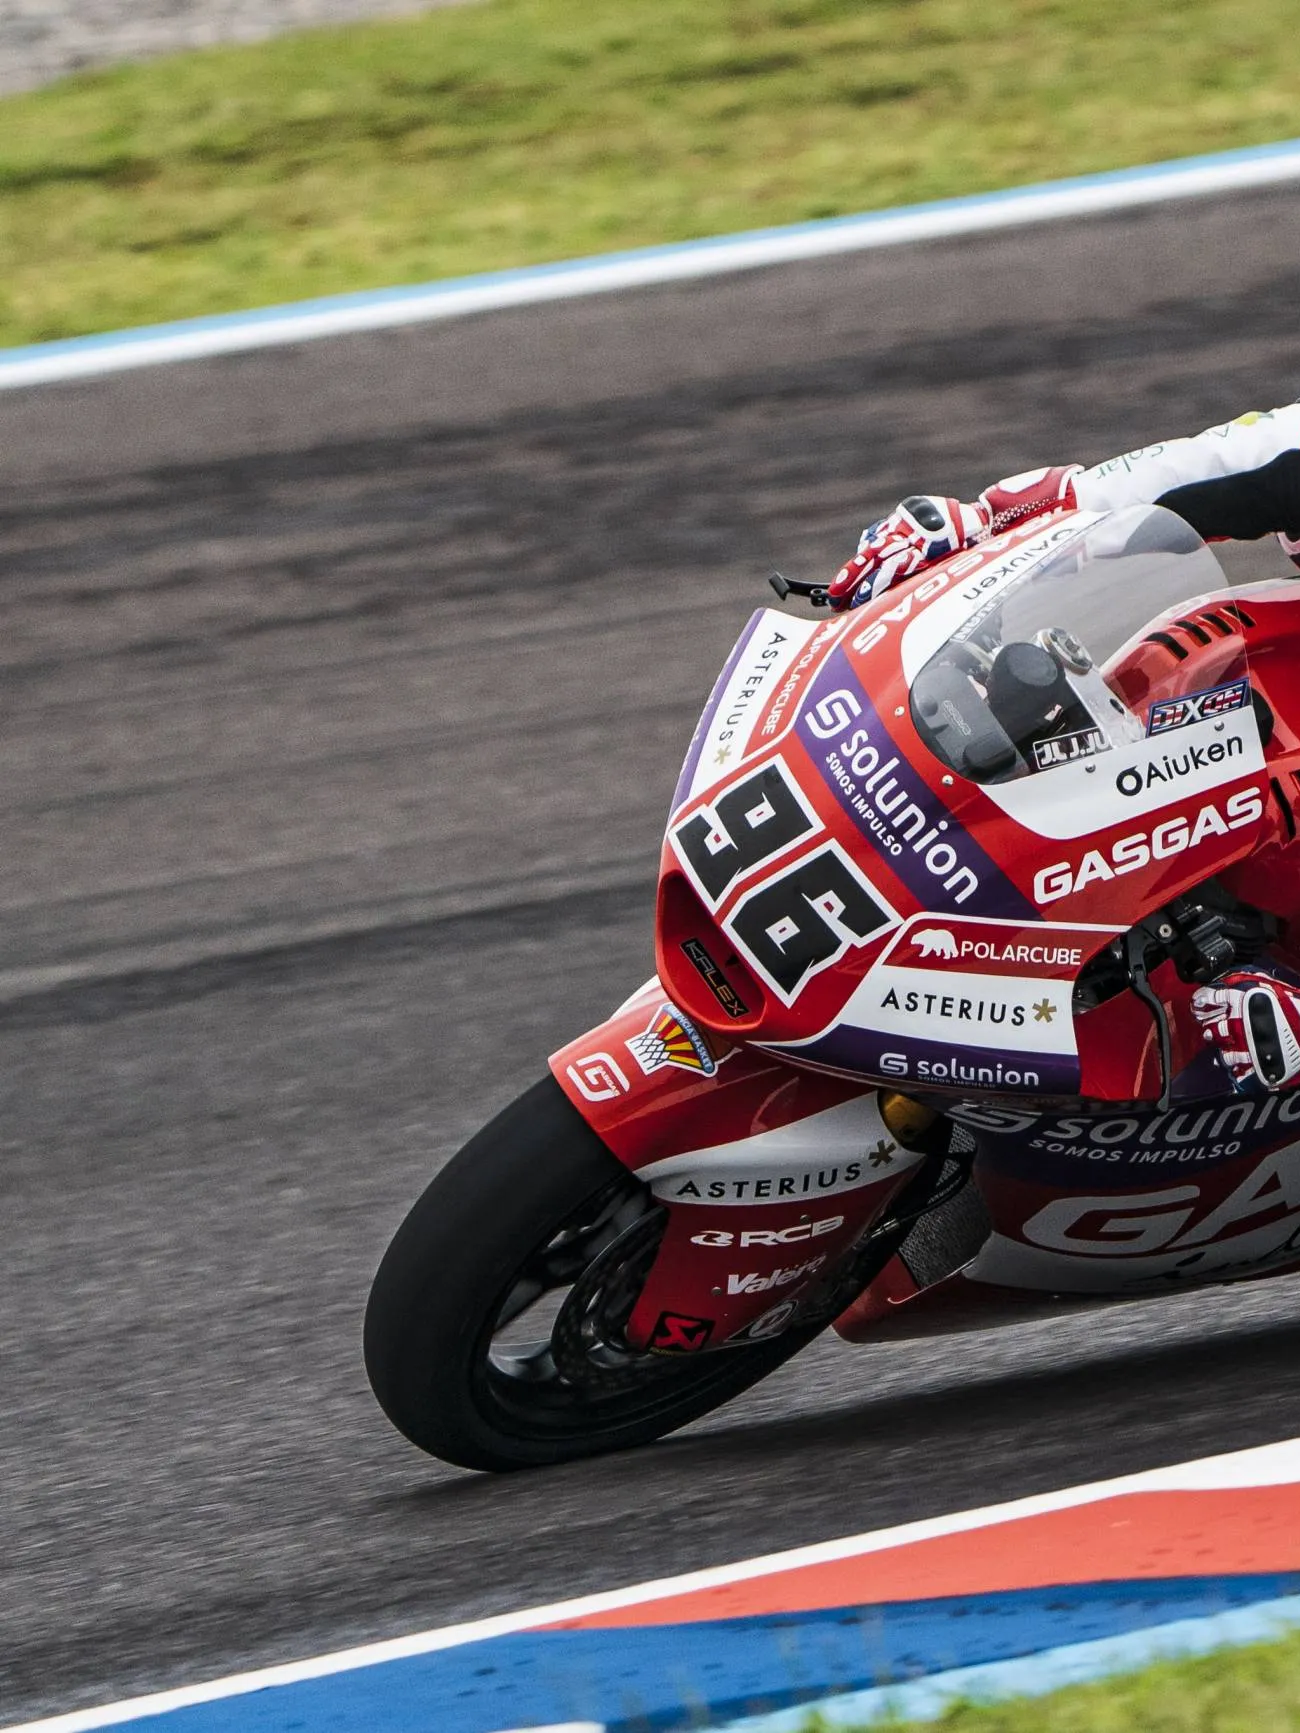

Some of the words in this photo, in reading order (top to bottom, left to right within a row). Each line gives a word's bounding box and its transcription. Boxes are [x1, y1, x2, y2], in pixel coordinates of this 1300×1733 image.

[718, 631, 788, 742] ASTERIUS
[761, 643, 822, 736] POLARCUBE
[1146, 736, 1243, 789] Aiuken
[825, 752, 856, 797] SOMOS
[850, 792, 902, 857] IMPULSO
[840, 729, 979, 904] solunion
[1033, 786, 1263, 905] GASGAS
[670, 755, 902, 1006] 96
[685, 942, 746, 1015] KALEX
[960, 940, 1082, 966] POLARCUBE
[880, 987, 1026, 1026] ASTERIUS
[916, 1057, 1040, 1086] solunion
[676, 1162, 862, 1199] ASTERIUS
[1028, 1138, 1123, 1163] SOMOS
[1127, 1140, 1242, 1163] IMPULSO
[739, 1215, 845, 1248] RCB
